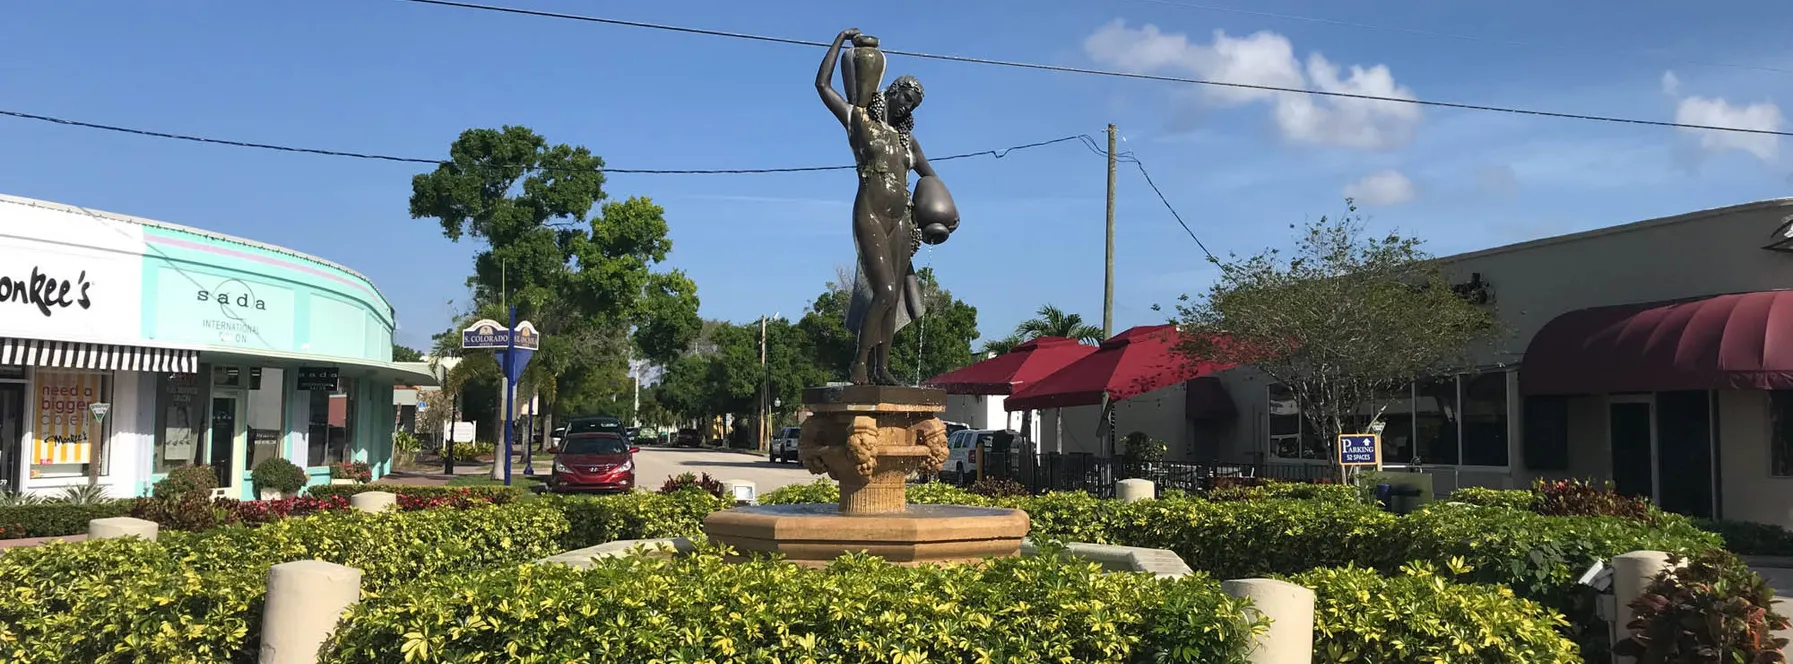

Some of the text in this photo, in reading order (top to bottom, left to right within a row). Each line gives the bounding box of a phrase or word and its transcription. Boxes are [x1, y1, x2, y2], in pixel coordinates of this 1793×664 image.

[197, 290, 266, 311] sada
[202, 319, 259, 334] INTERNATIONAL
[470, 335, 509, 343] COLORADO
[42, 385, 92, 396] need a
[41, 396, 90, 414] bigger
